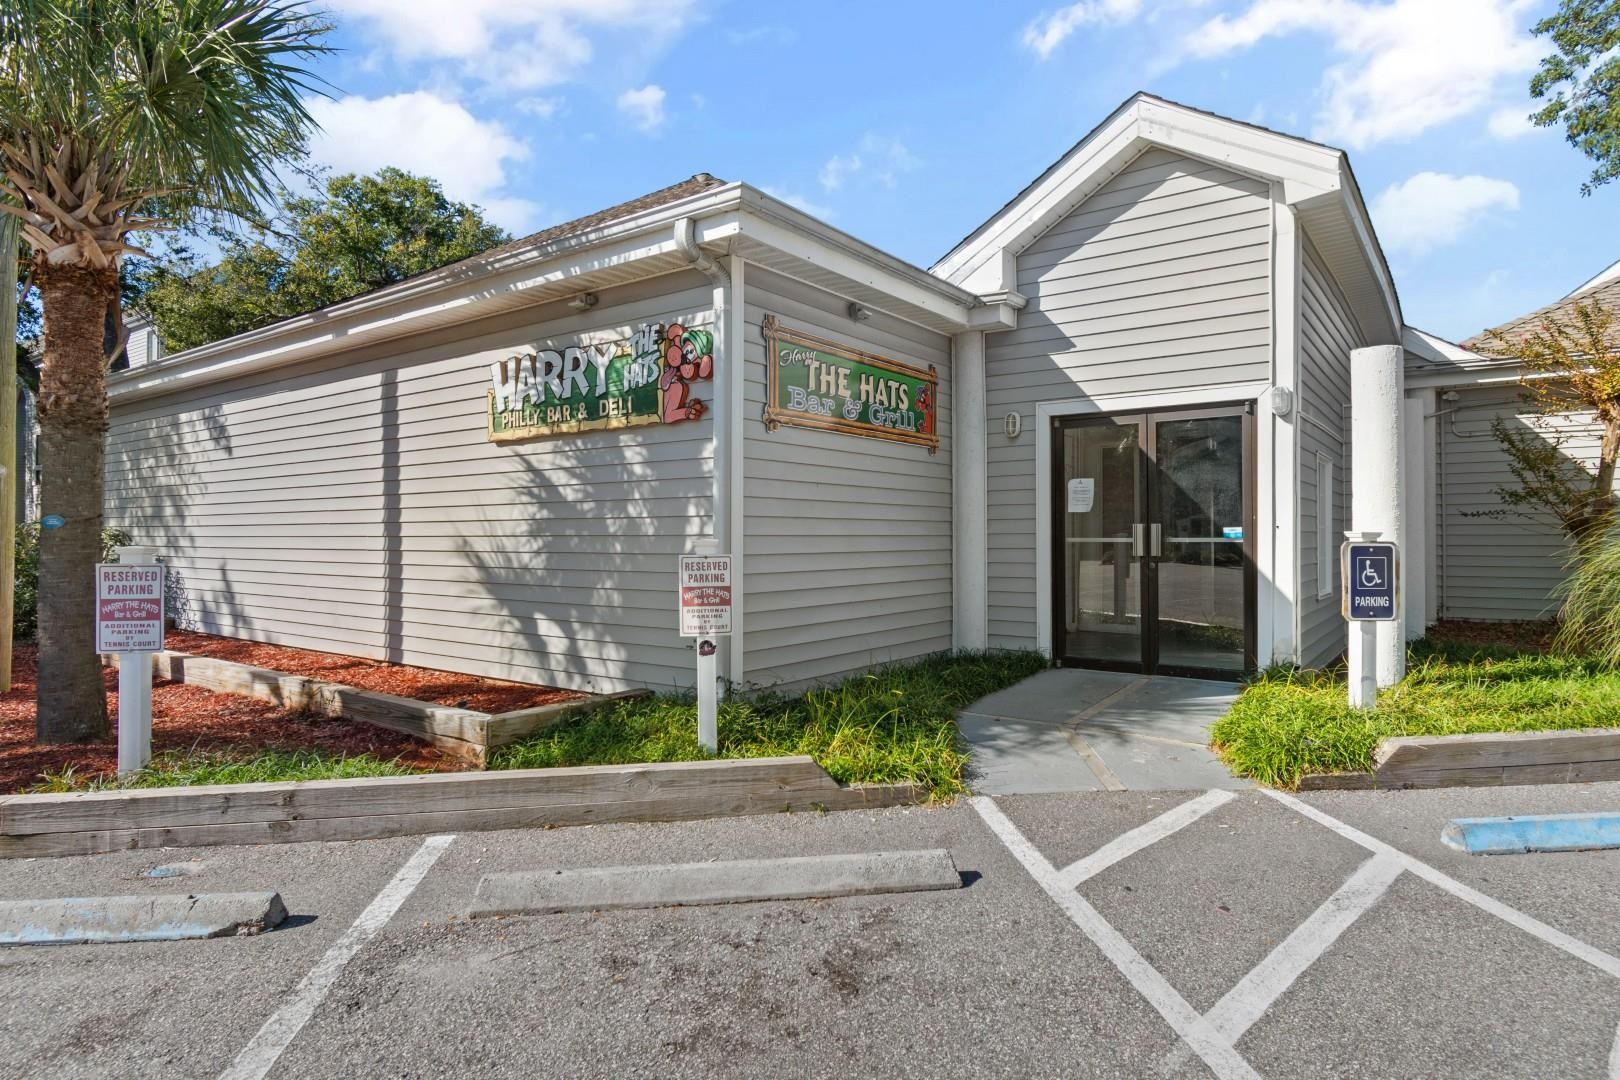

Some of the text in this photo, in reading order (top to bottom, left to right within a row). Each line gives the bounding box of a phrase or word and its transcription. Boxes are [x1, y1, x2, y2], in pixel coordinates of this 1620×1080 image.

[630, 323, 659, 360] THE
[780, 349, 816, 367] Harry
[490, 342, 617, 414] HARRY
[624, 351, 660, 391] HATS
[807, 361, 909, 411] THE HATS
[502, 397, 632, 429] PHILLY BAR & DELI
[787, 385, 916, 431] Bar & Grill
[685, 562, 728, 571] RESERVED
[104, 572, 157, 582] RESERVED
[688, 573, 725, 583] PARKING
[108, 584, 153, 594] PARKING
[684, 589, 701, 600] HARRY
[102, 601, 124, 614] HARRY
[141, 602, 159, 614] HATS
[1355, 596, 1389, 607] PARKING
